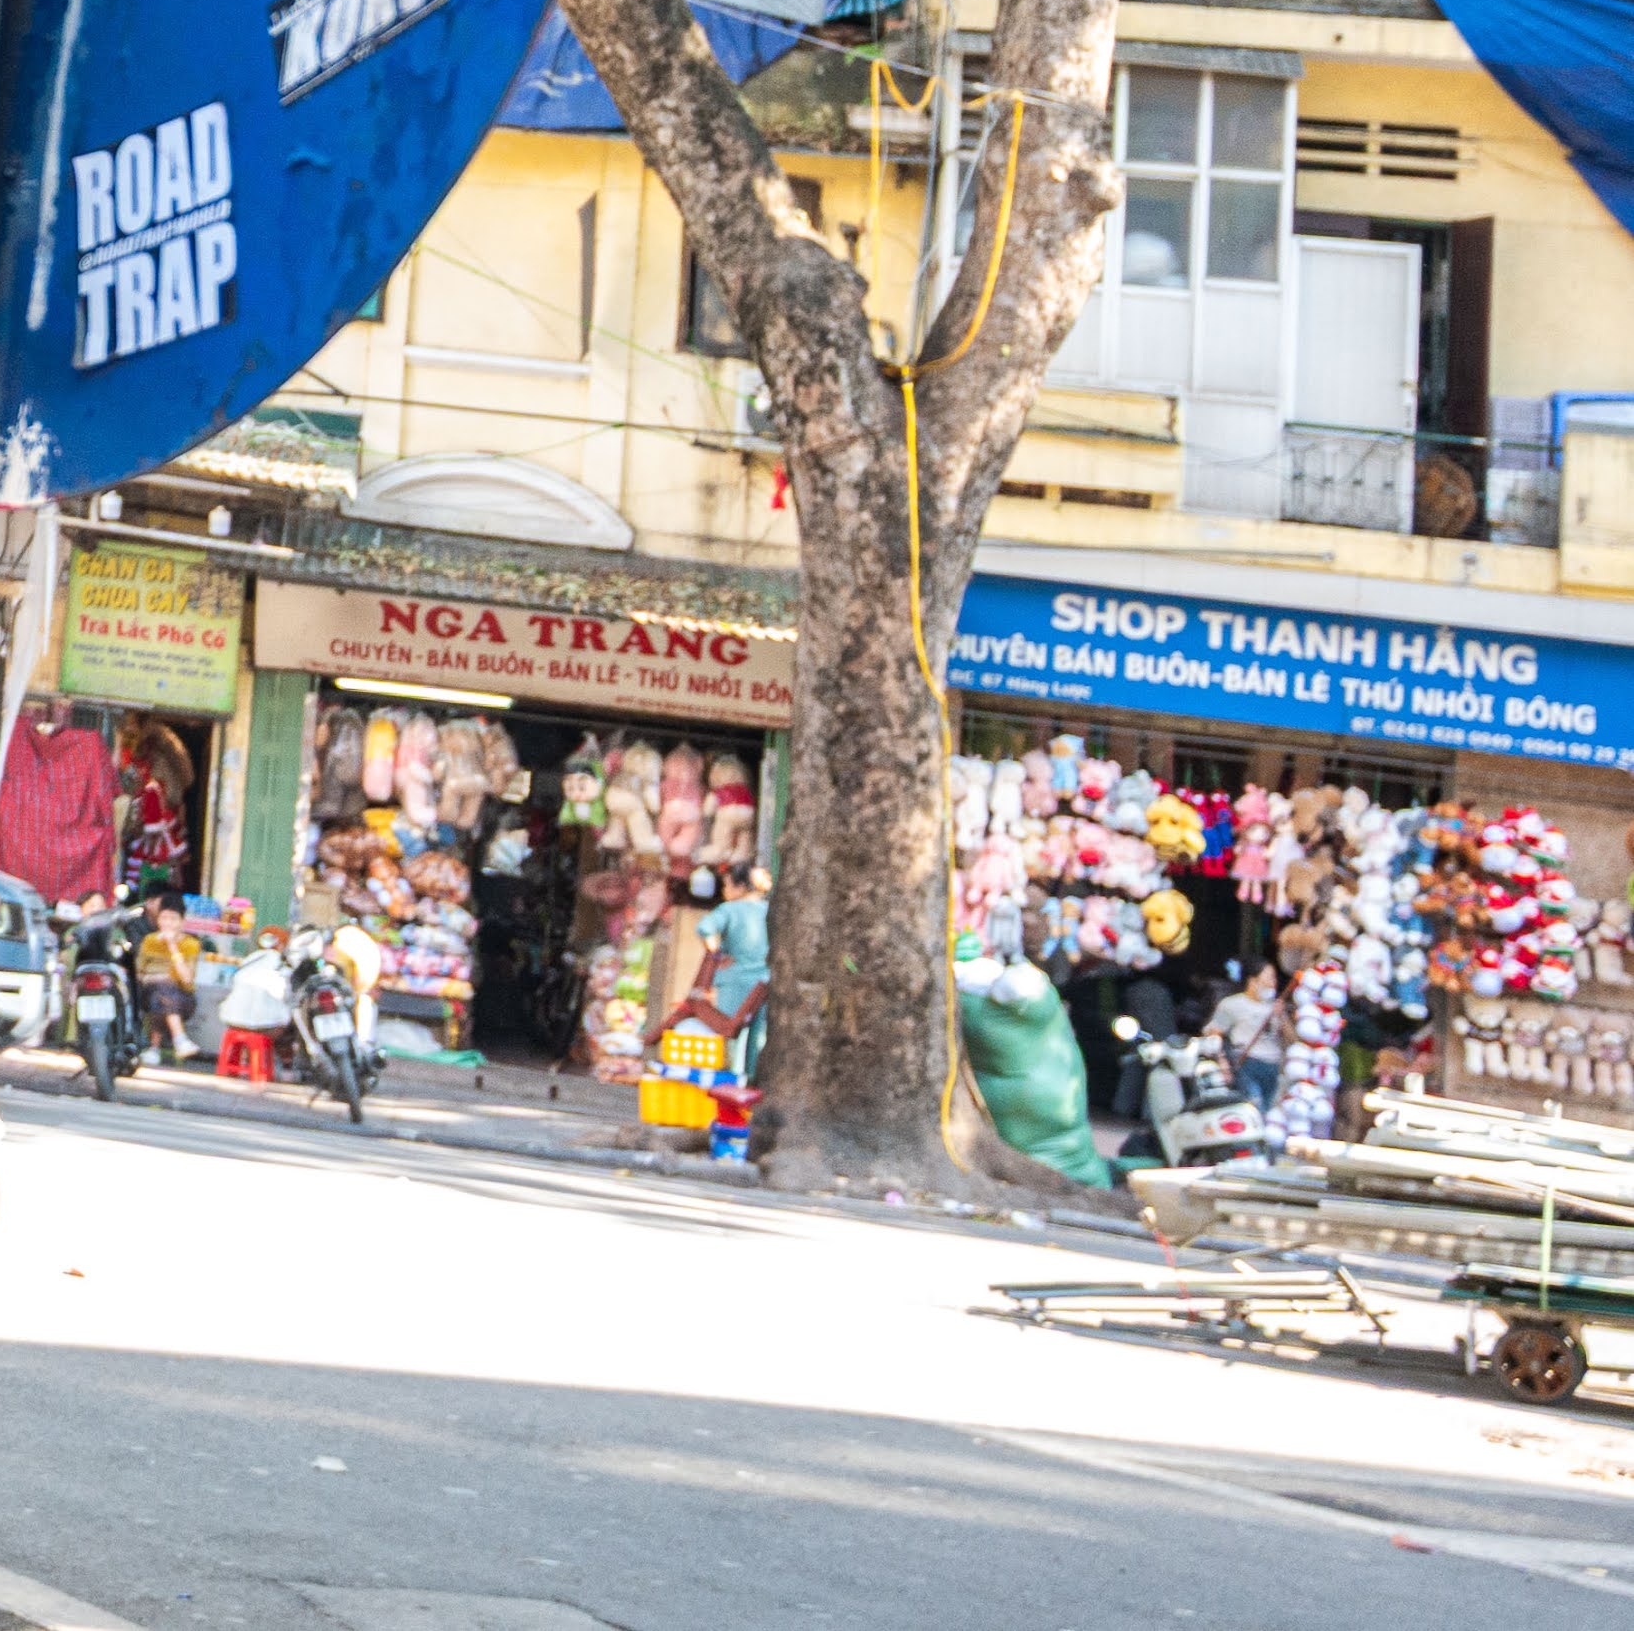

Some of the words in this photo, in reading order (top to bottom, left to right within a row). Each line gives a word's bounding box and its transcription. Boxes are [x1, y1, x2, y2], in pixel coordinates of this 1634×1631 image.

[72, 102, 233, 251] ROAD
[77, 222, 237, 367] TRAP
[329, 637, 413, 665] CHUYÊN
[425, 646, 469, 671] BÁN
[750, 677, 795, 706] BÔN
[379, 599, 508, 645] NGA
[528, 614, 750, 667] TRANG
[1050, 592, 1187, 644] SHOP
[1198, 609, 1378, 669] THANH
[950, 631, 1048, 671] HUYÊN
[1052, 642, 1117, 679] BÁN
[1340, 675, 1405, 713] THÚ
[1503, 694, 1598, 736] BÔNG
